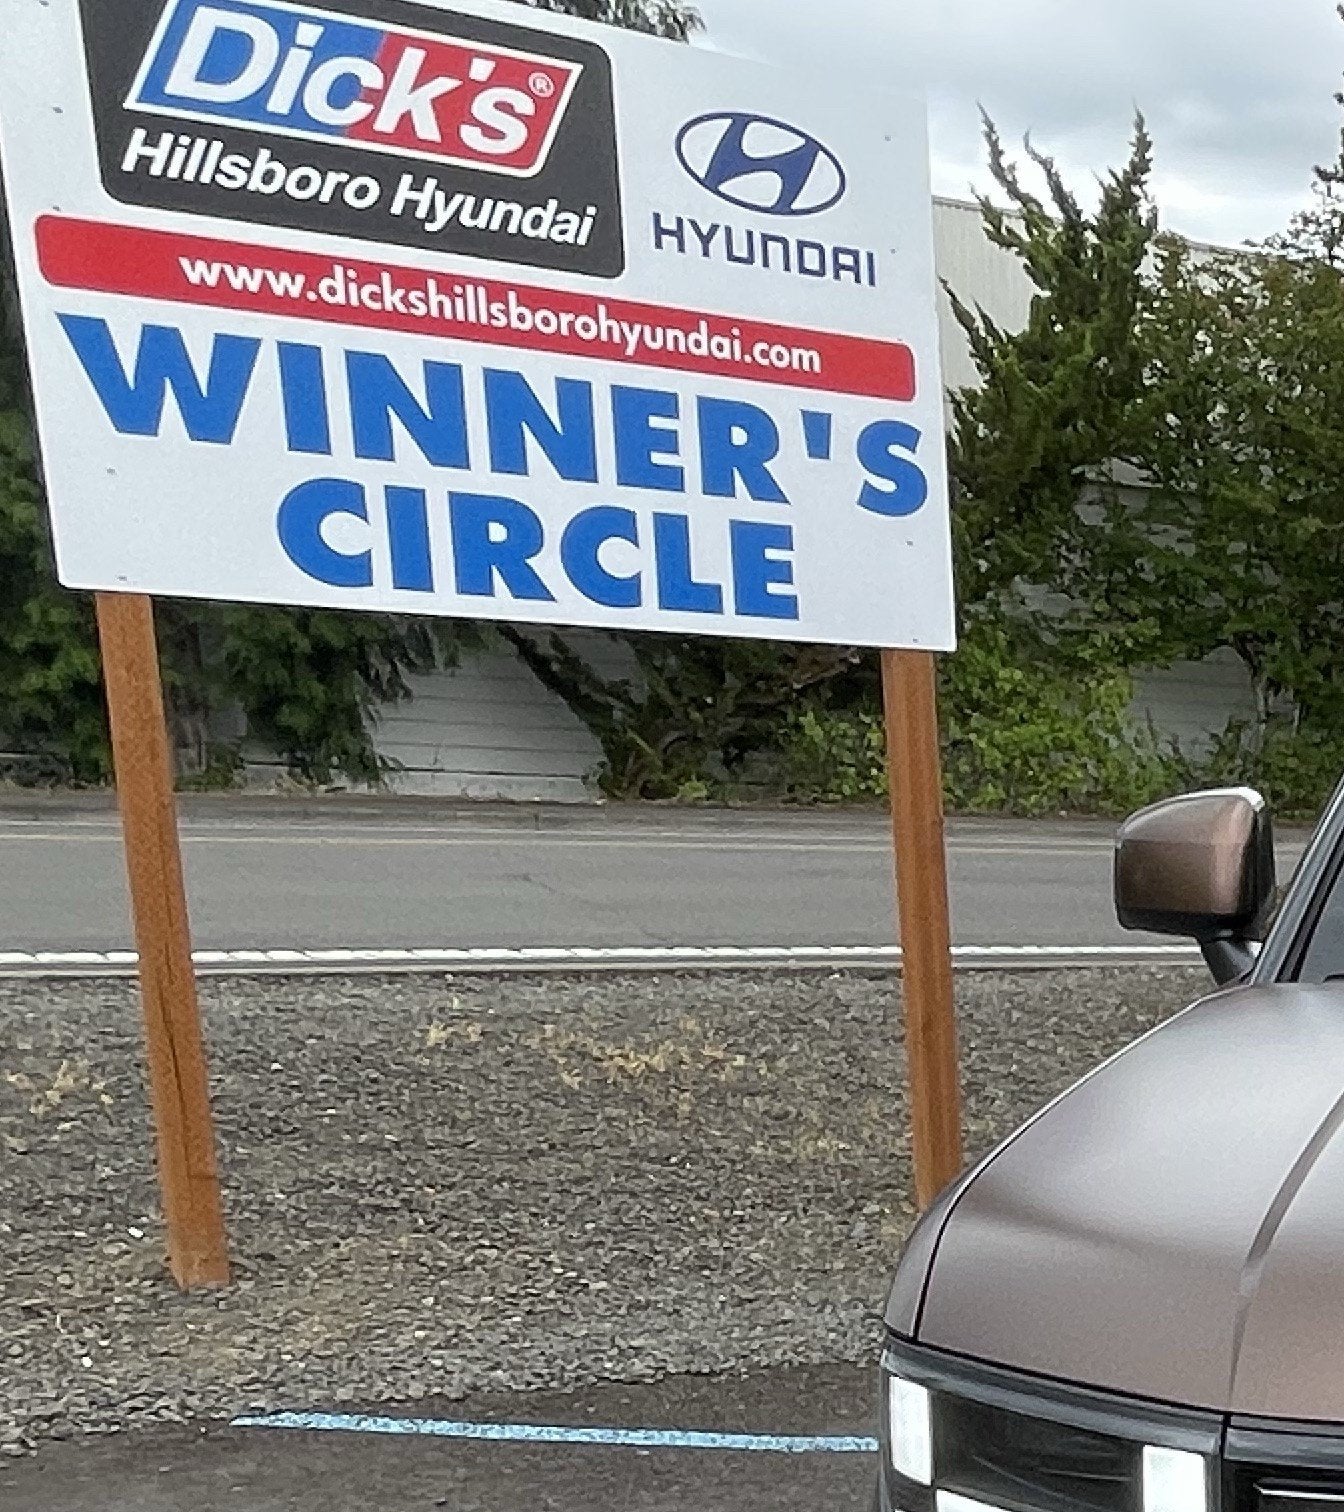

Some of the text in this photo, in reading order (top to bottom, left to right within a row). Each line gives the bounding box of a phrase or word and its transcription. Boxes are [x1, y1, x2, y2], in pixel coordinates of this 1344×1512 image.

[122, 128, 597, 247] Hillsboro Hyundai
[653, 211, 876, 287] HYUNDAI
[179, 257, 822, 375] www.dickshillsborohyundai.com
[57, 312, 929, 518] WINNER'S
[277, 478, 799, 619] CIRCLE
